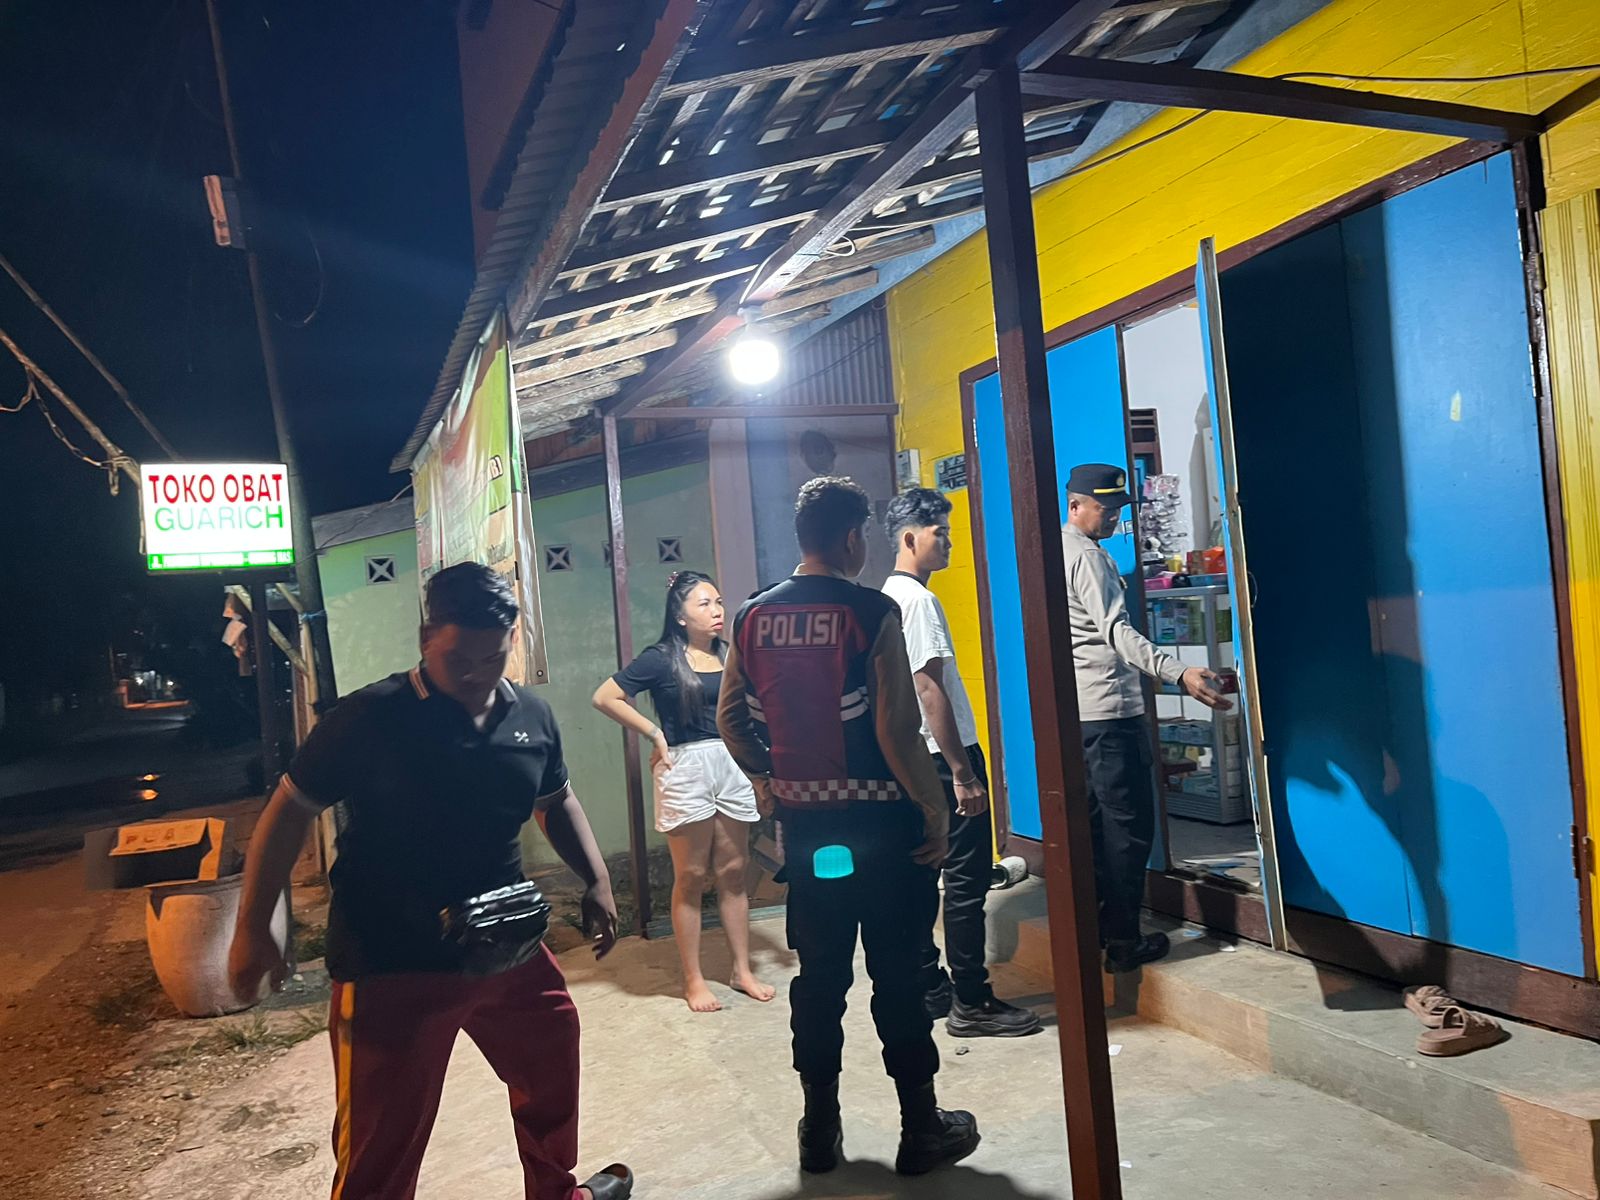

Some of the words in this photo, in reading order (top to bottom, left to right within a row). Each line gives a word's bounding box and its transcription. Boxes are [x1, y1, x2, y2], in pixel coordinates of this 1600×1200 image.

[148, 474, 215, 503] TOKO
[223, 474, 282, 502] OBAT
[154, 505, 283, 531] GUARICH
[756, 612, 838, 647] POLISI
